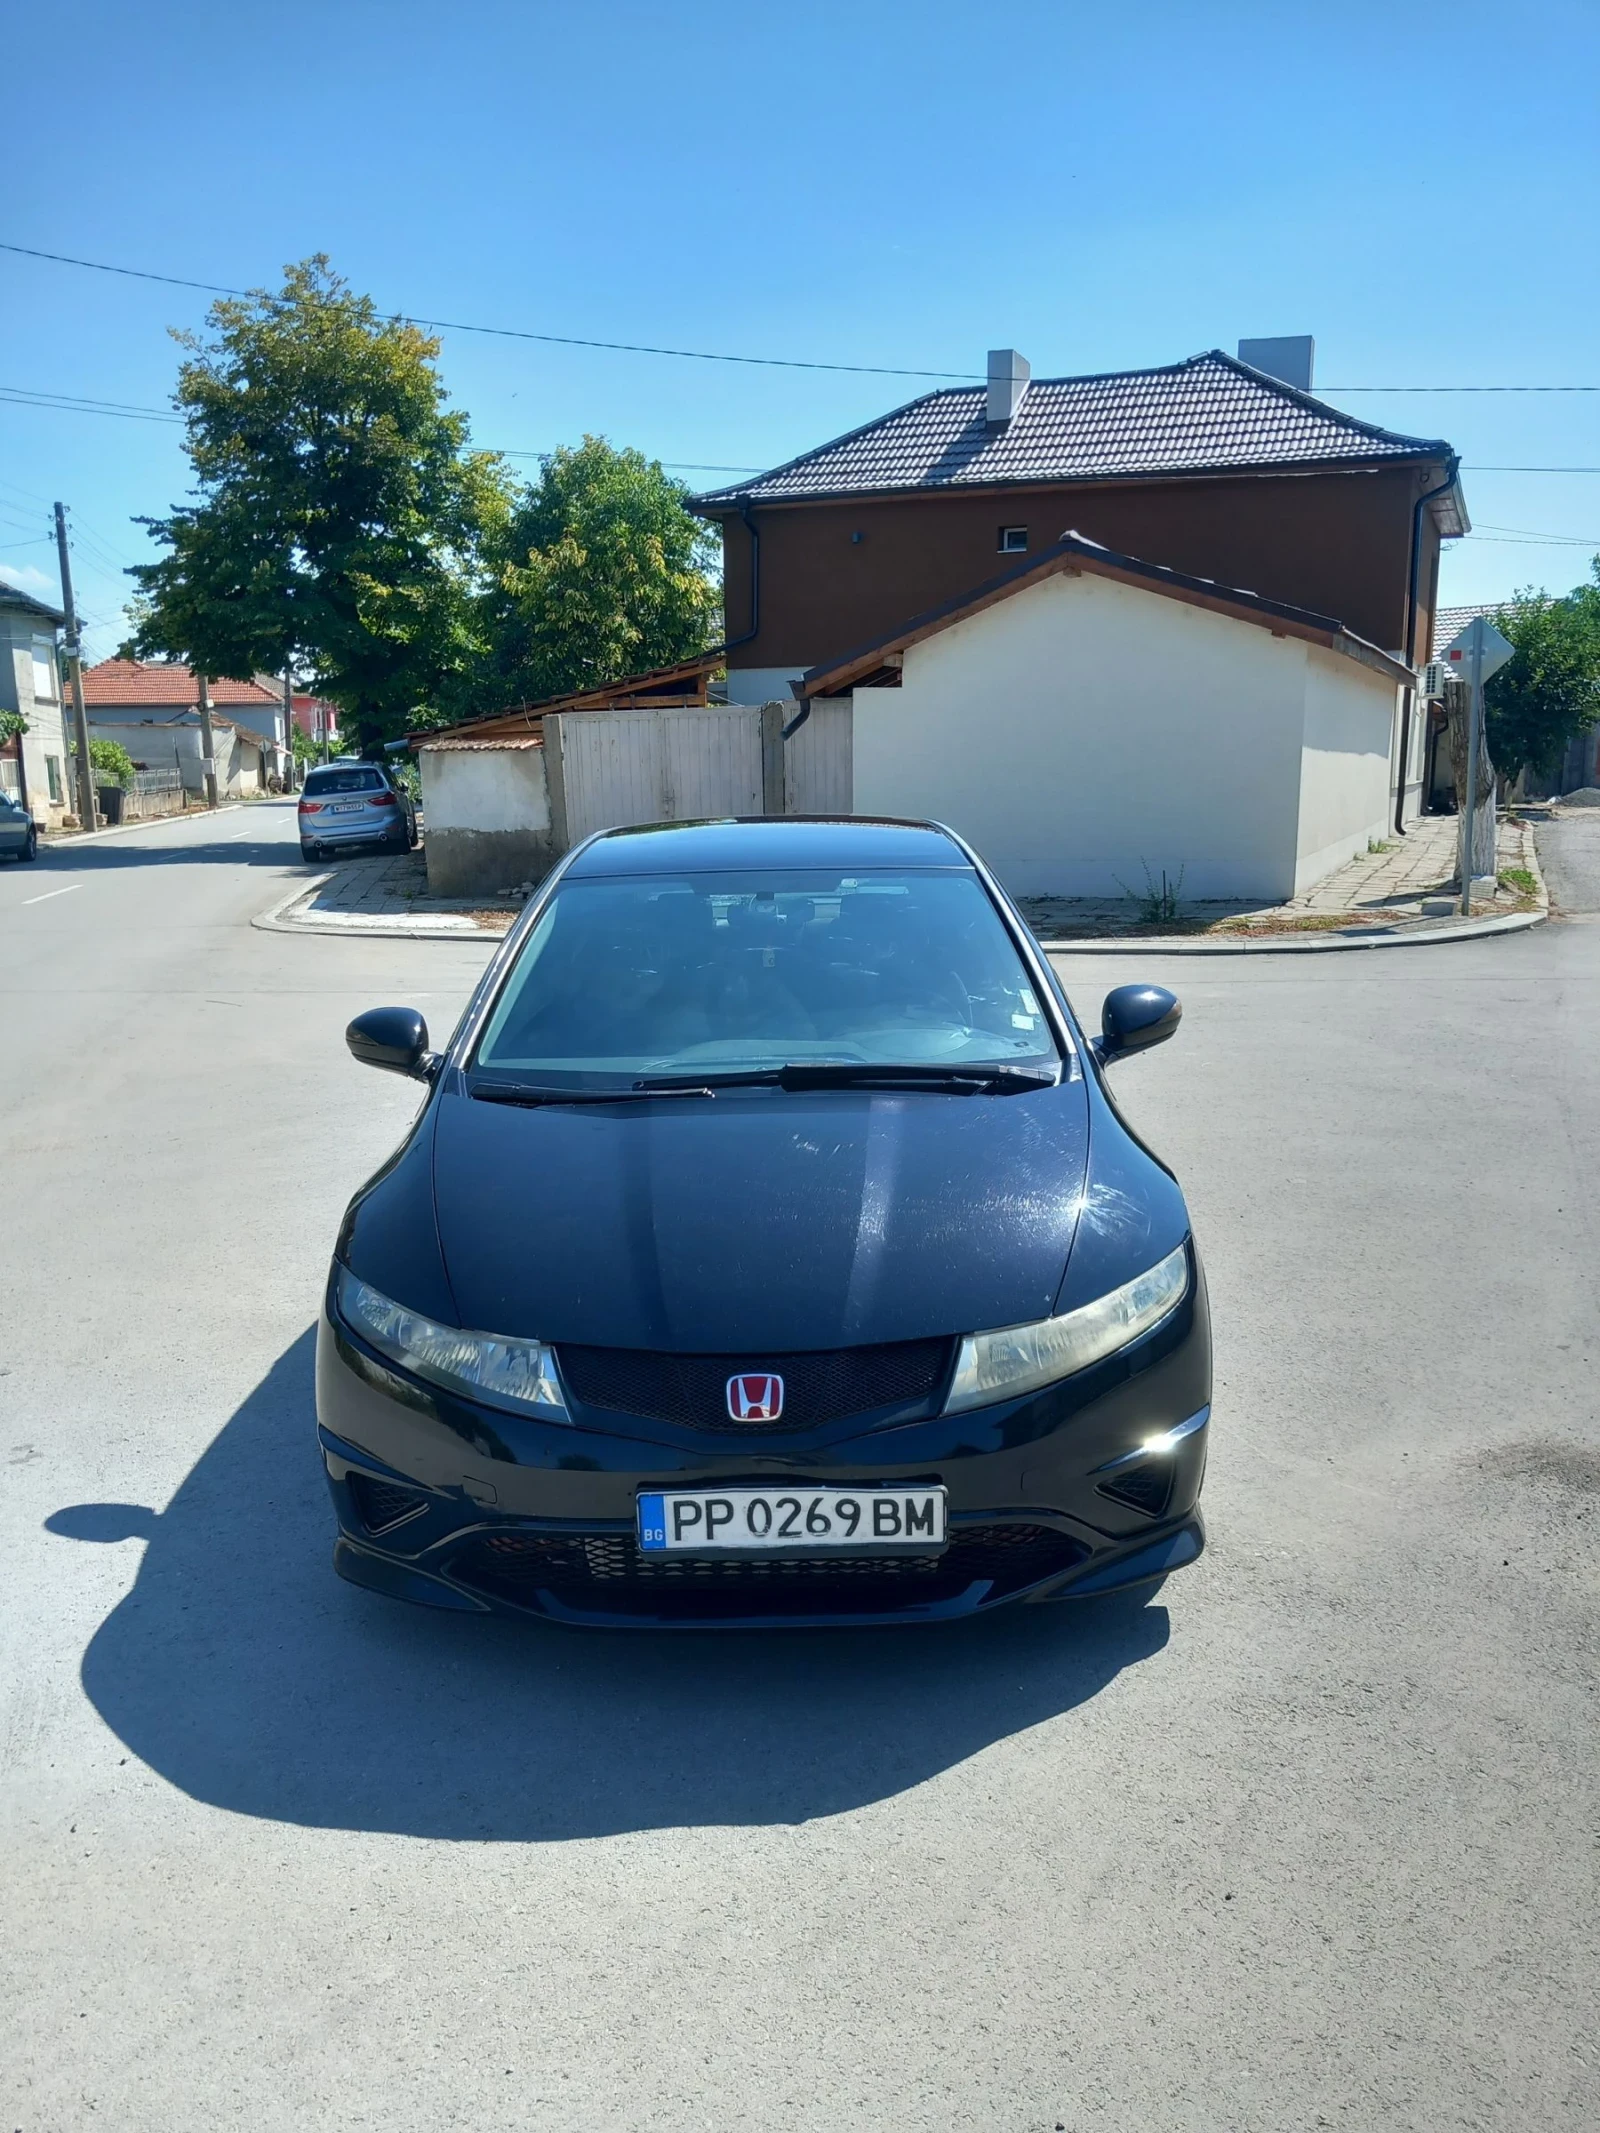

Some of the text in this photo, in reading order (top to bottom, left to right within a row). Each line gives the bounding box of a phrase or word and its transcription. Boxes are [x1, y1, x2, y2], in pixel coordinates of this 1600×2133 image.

[673, 1497, 935, 1541] PP 0269 BM
[643, 1528, 664, 1541] BG
